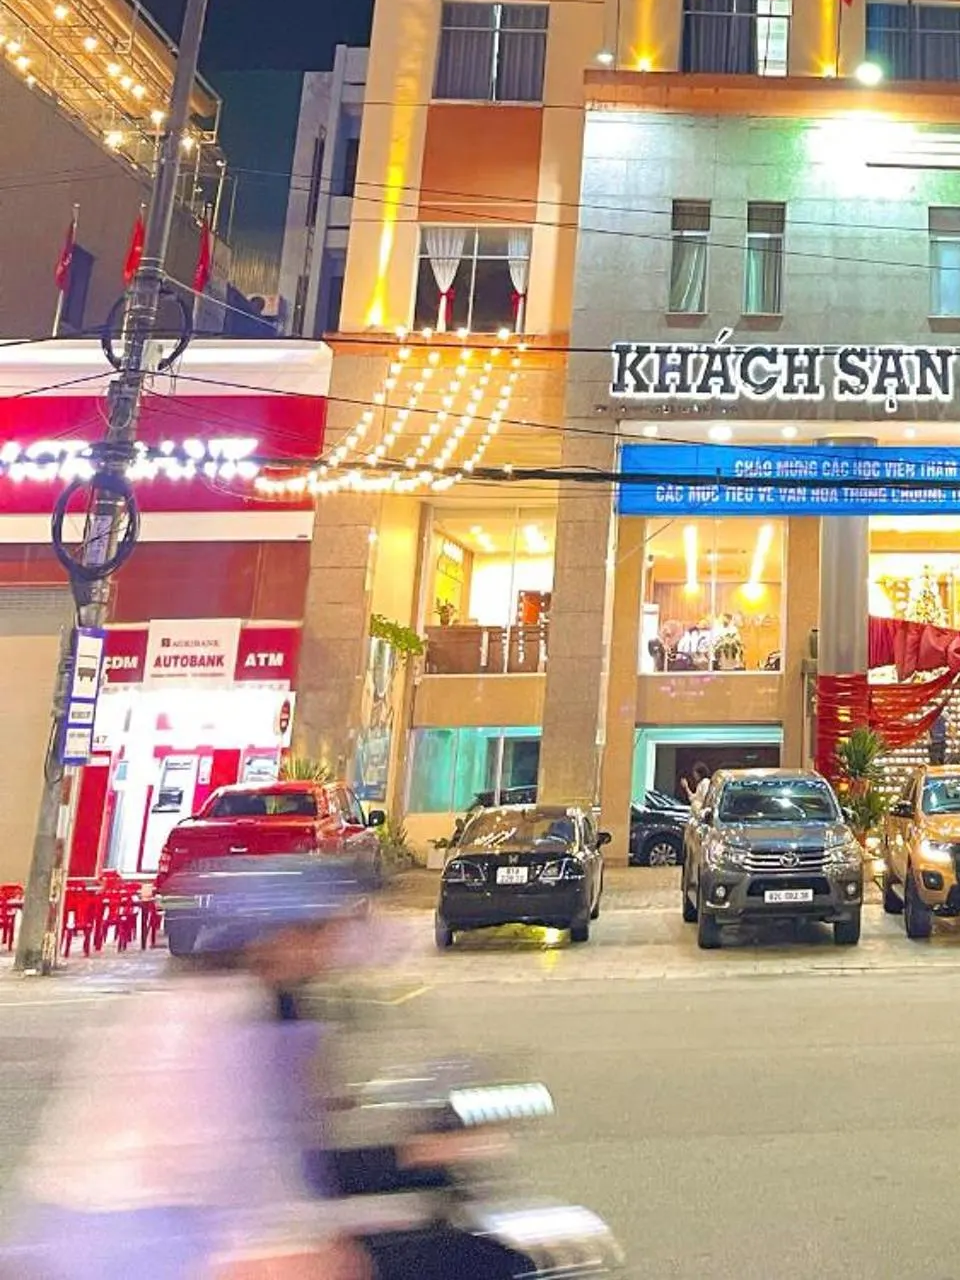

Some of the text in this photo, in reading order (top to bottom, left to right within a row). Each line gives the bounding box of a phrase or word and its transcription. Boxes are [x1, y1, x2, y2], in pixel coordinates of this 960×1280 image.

[611, 329, 821, 397] KHÁCH
[835, 347, 952, 411] SẠN
[919, 459, 957, 477] THAM
[153, 655, 225, 668] AUTOBANK
[245, 653, 284, 666] ATM
